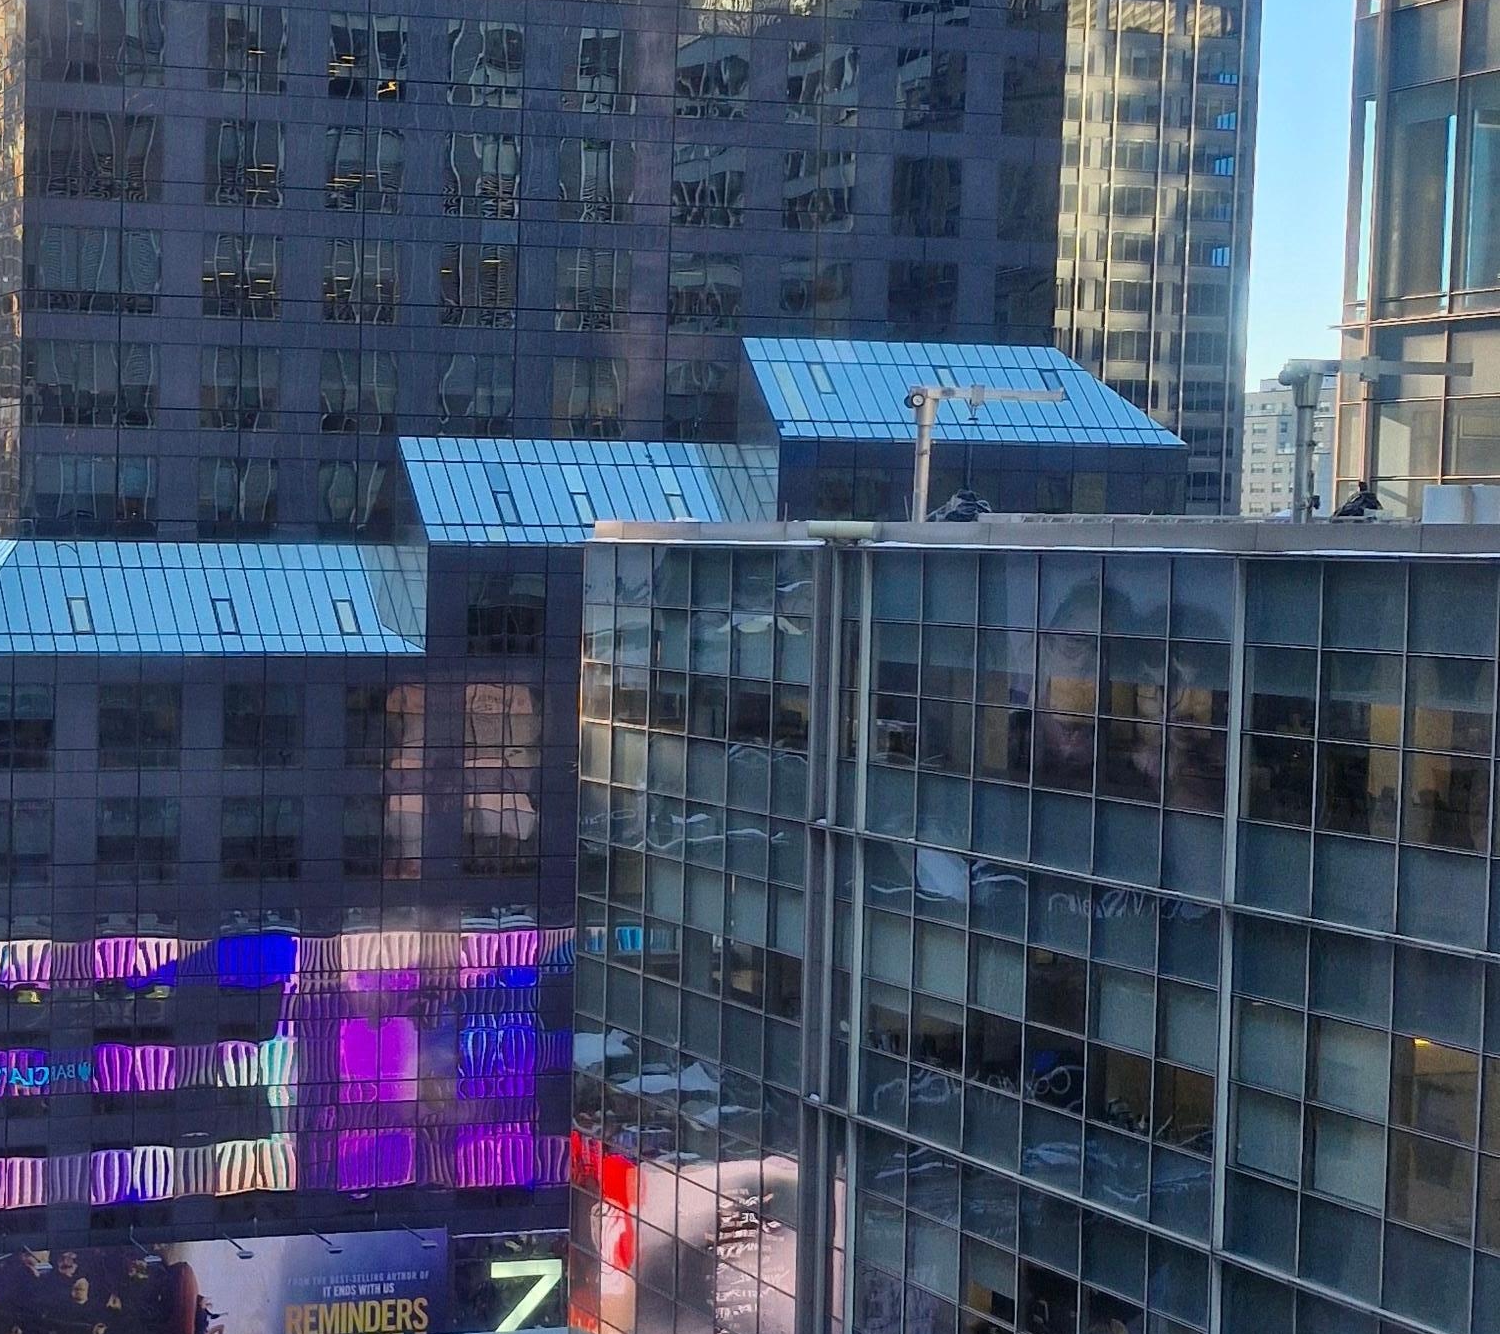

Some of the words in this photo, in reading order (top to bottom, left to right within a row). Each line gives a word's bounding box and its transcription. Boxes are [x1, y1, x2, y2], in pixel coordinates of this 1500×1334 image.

[322, 1286, 331, 1298] IT
[334, 1285, 357, 1297] ENDS
[358, 1283, 380, 1296] WITH
[383, 1282, 395, 1294] US
